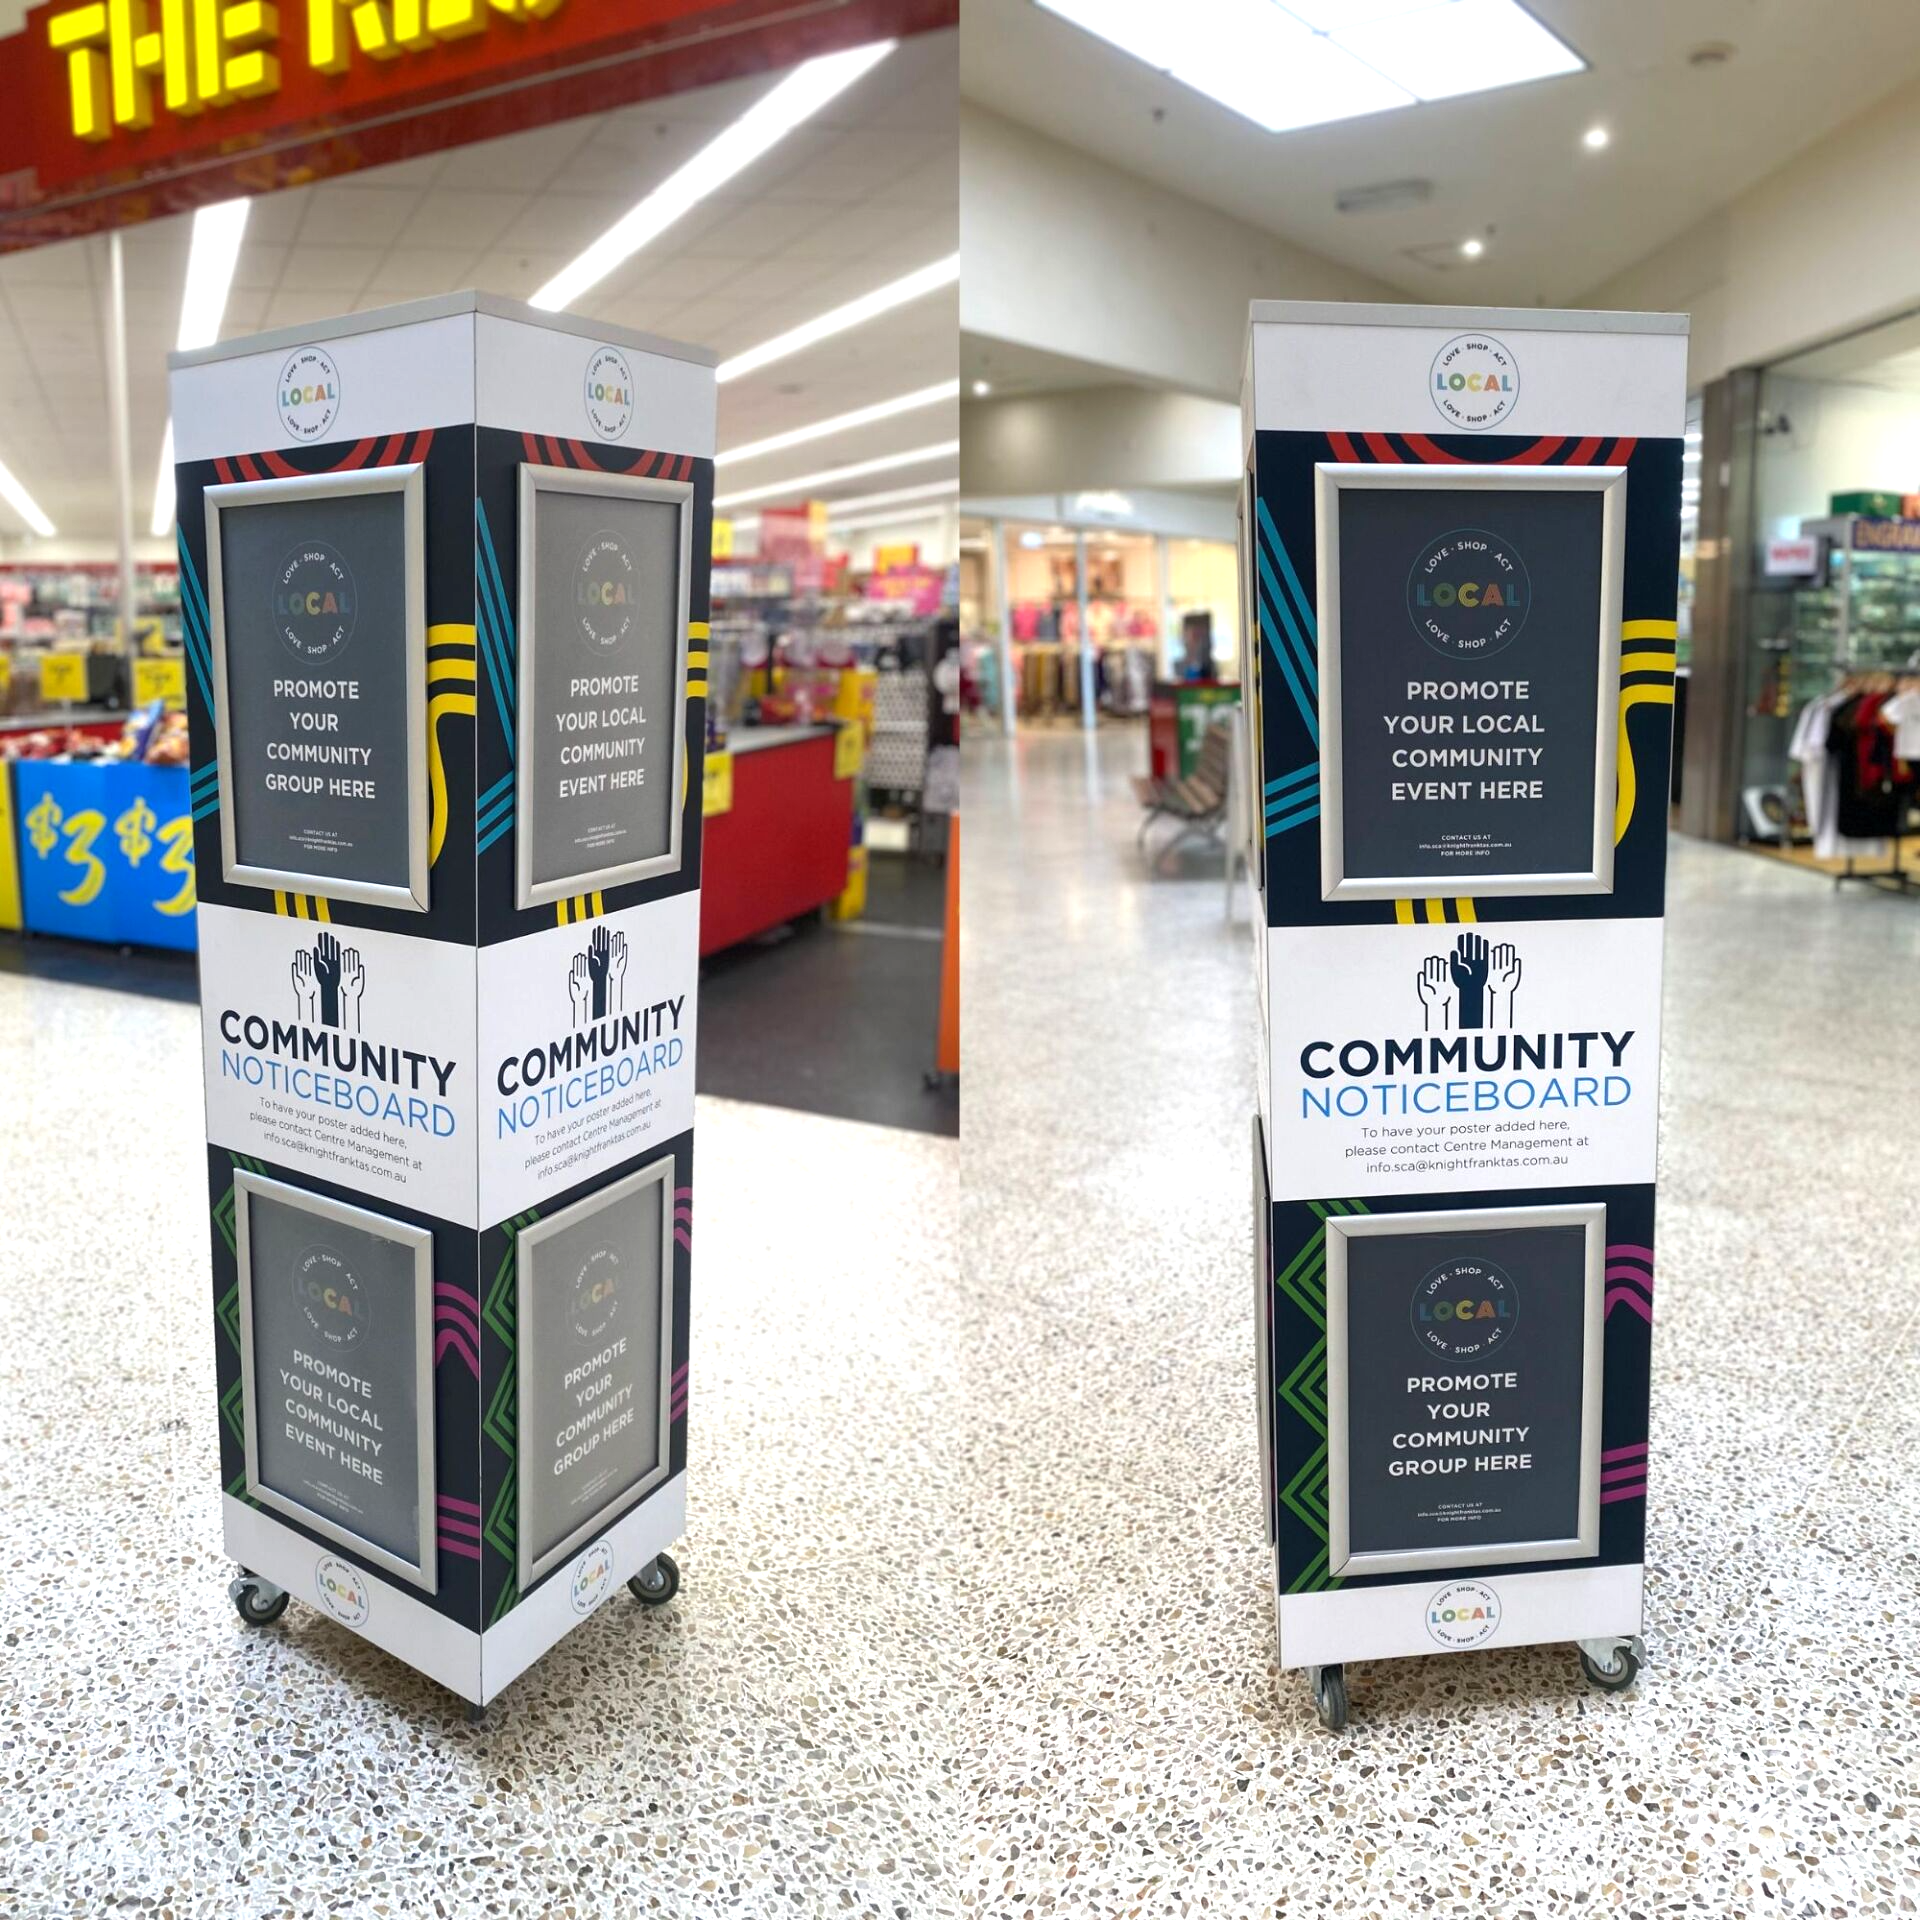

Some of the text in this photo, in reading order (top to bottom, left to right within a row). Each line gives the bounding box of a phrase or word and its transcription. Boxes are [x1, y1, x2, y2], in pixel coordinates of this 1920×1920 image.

[49, 0, 280, 141] THE
[285, 355, 331, 383] LOVE SHOP ACT
[1442, 343, 1507, 367] LOVE SHOP ACT
[282, 382, 335, 407] LOCAL
[588, 382, 630, 406] LOCAL
[1437, 373, 1512, 392] LOCAL
[287, 409, 331, 434] LOVE SHOP ACT
[1443, 399, 1506, 423] LOVE SHOP ACT
[282, 552, 344, 585] LOVE SHOP ACT
[1424, 541, 1514, 574] LOVE SHOP ACT
[278, 592, 351, 615] LOCAL
[1417, 582, 1520, 607] LOCAL
[285, 625, 345, 654] LOVE SHOP ACT
[1425, 618, 1511, 649] LOVE SHOP ACT
[274, 680, 360, 699] PROMOTE
[570, 675, 639, 698] PROMOTE
[1407, 681, 1529, 700] PROMOTE
[290, 712, 339, 732] YOUR
[556, 707, 646, 732] YOUR LOCAL
[1383, 715, 1545, 734] YOUR LOCAL
[267, 743, 371, 765] COMMUNITY
[561, 737, 645, 764] COMMUNITY
[1392, 748, 1543, 767] COMMUNITY
[266, 774, 375, 798] GROUP HERE
[560, 769, 644, 798] EVENT HERE
[1392, 781, 1543, 800] EVENT HERE
[25, 792, 106, 906] $3
[114, 796, 197, 916] $3
[220, 1010, 456, 1097] COMMUNITY
[498, 995, 685, 1096] COMMUNITY
[1300, 1031, 1636, 1079] COMMUNITY
[222, 1049, 455, 1137] NOTICEBOARD
[498, 1038, 682, 1139] NOTICEBOARD
[1302, 1076, 1631, 1119] NOTICEBOARD
[260, 1097, 407, 1149] To have your poster added here,
[524, 1100, 661, 1170] please contact Centre Management at
[535, 1135, 544, 1146] To
[547, 1125, 566, 1141] have
[567, 1118, 584, 1134] your
[586, 1107, 609, 1125] poster
[611, 1097, 634, 1112] added
[1361, 1119, 1570, 1138] To have your poster added here,
[250, 1112, 423, 1171] please contact Centre Management at
[538, 1121, 651, 1180] info.sca@knightfranktas.com.au
[1345, 1137, 1589, 1158] please contact Centre Management at
[263, 1131, 407, 1183] info.sca@knightfranktas.com.au
[1366, 1155, 1568, 1173] info.sca@knightfranktas.com.au
[302, 1254, 358, 1290] LOVE SHOP ACT
[1426, 1267, 1505, 1295] LOVE SHOP ACT
[303, 1307, 358, 1343] LOVE SHOP ACT
[1420, 1300, 1510, 1322] LOCAL
[1426, 1327, 1502, 1353] LOVE SHOP ACT
[294, 1350, 372, 1399] PROMOTE
[564, 1337, 627, 1389] PROMOTE
[576, 1374, 612, 1407] YOUR
[1407, 1372, 1517, 1393] PROMOTE
[280, 1369, 383, 1431] YOUR LOCAL
[1427, 1402, 1490, 1420] YOUR
[286, 1399, 382, 1457] COMMUNITY
[556, 1384, 632, 1447] COMMUNITY
[554, 1408, 634, 1476] GROUP HERE
[1393, 1426, 1529, 1449] COMMUNITY
[286, 1423, 383, 1486] EVENT HERE
[1389, 1454, 1532, 1476] GROUP HERE
[320, 1573, 364, 1609] LOCAL
[1436, 1591, 1452, 1606] LOVE
[1479, 1591, 1491, 1601] ACT
[1432, 1607, 1495, 1623] LOCAL
[1437, 1629, 1452, 1641] LOVE
[1480, 1625, 1490, 1636] ACT
